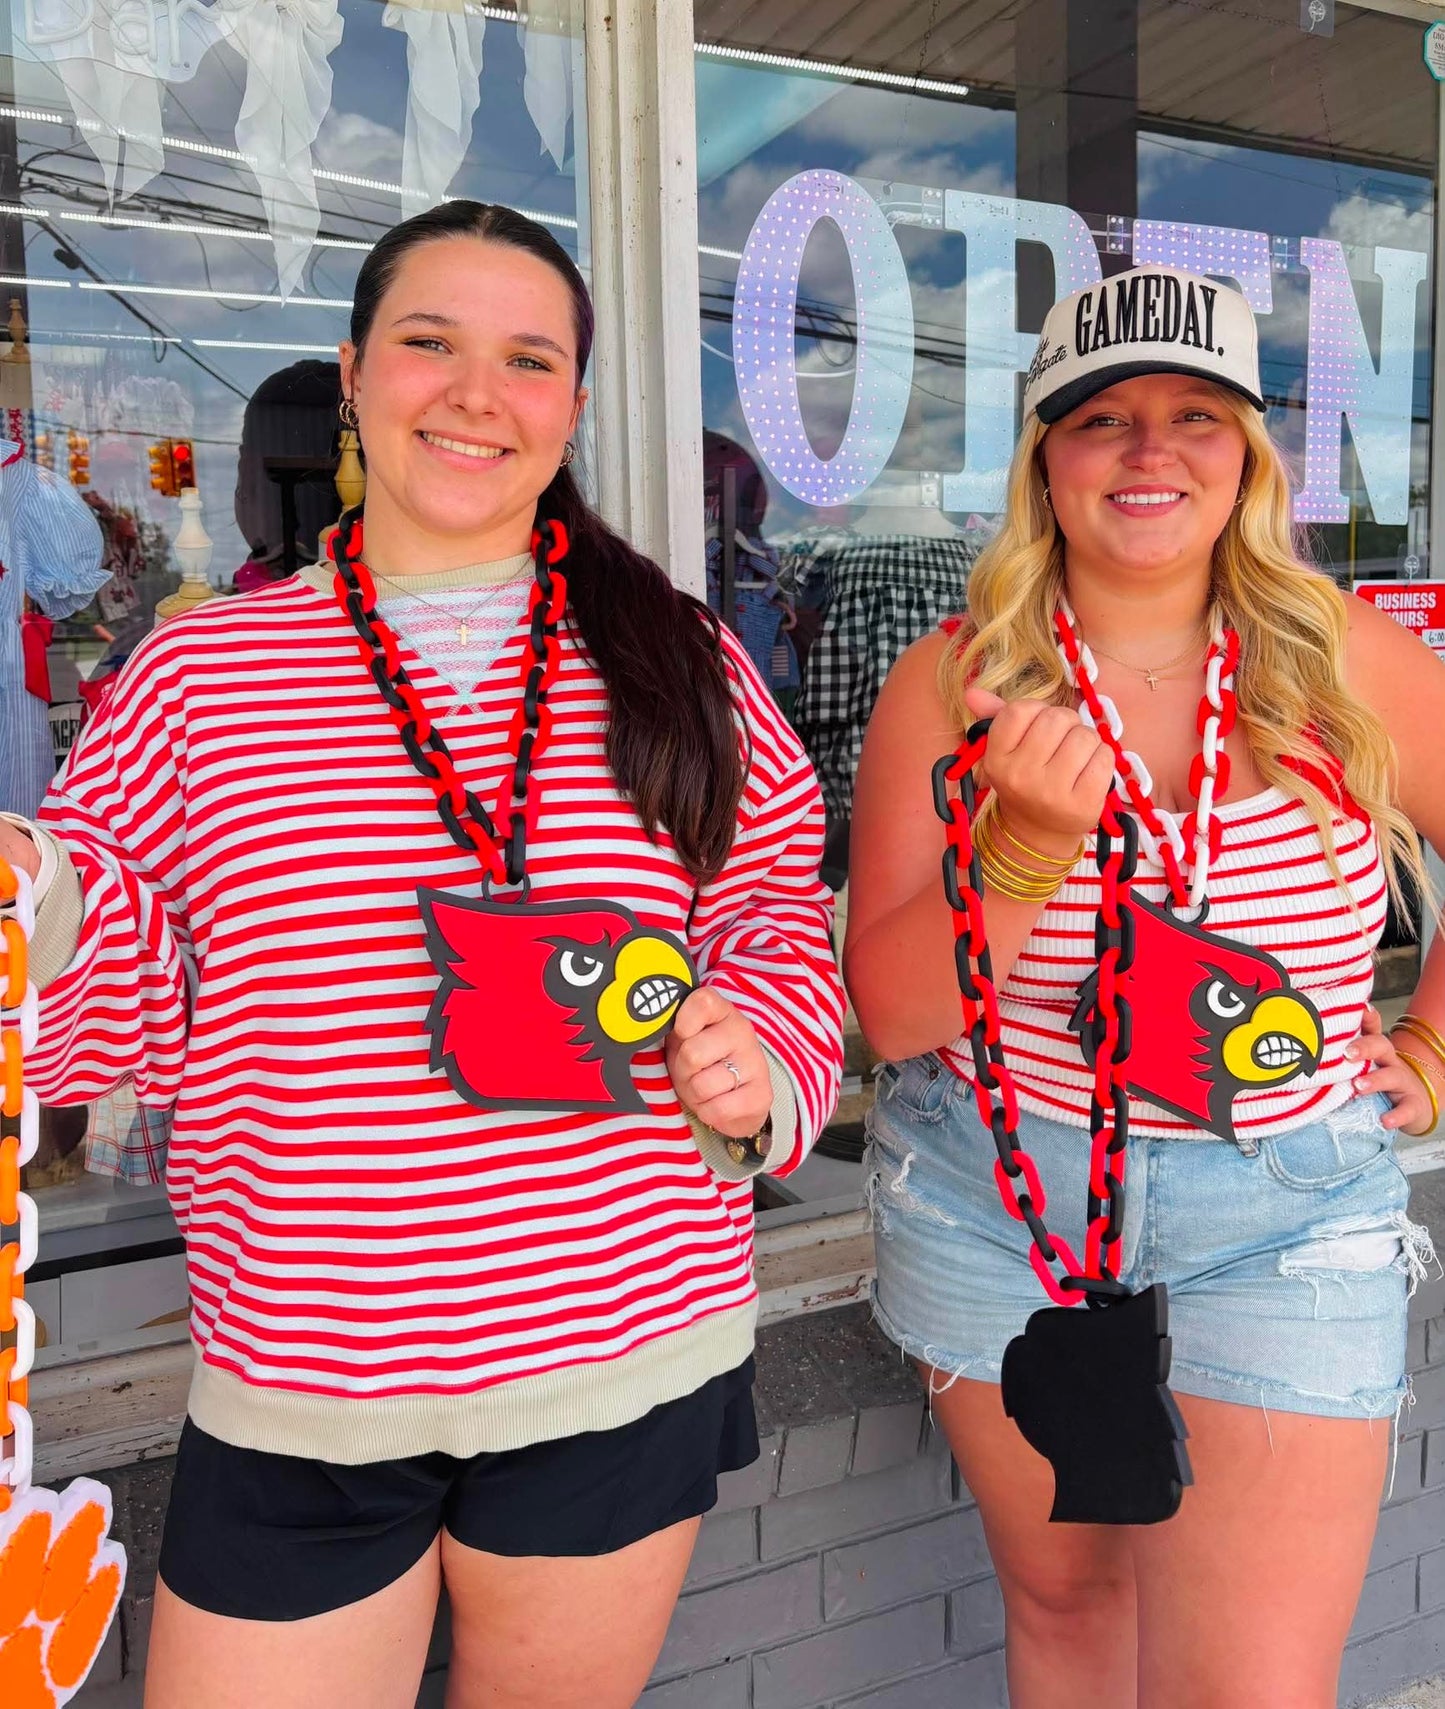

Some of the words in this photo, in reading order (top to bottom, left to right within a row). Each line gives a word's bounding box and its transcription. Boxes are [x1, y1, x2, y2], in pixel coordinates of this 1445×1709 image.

[1075, 274, 1224, 357] GAMEDAY.
[733, 169, 1427, 525] OPN
[1375, 592, 1437, 609] BUSINESS
[1388, 610, 1428, 627] OURS:
